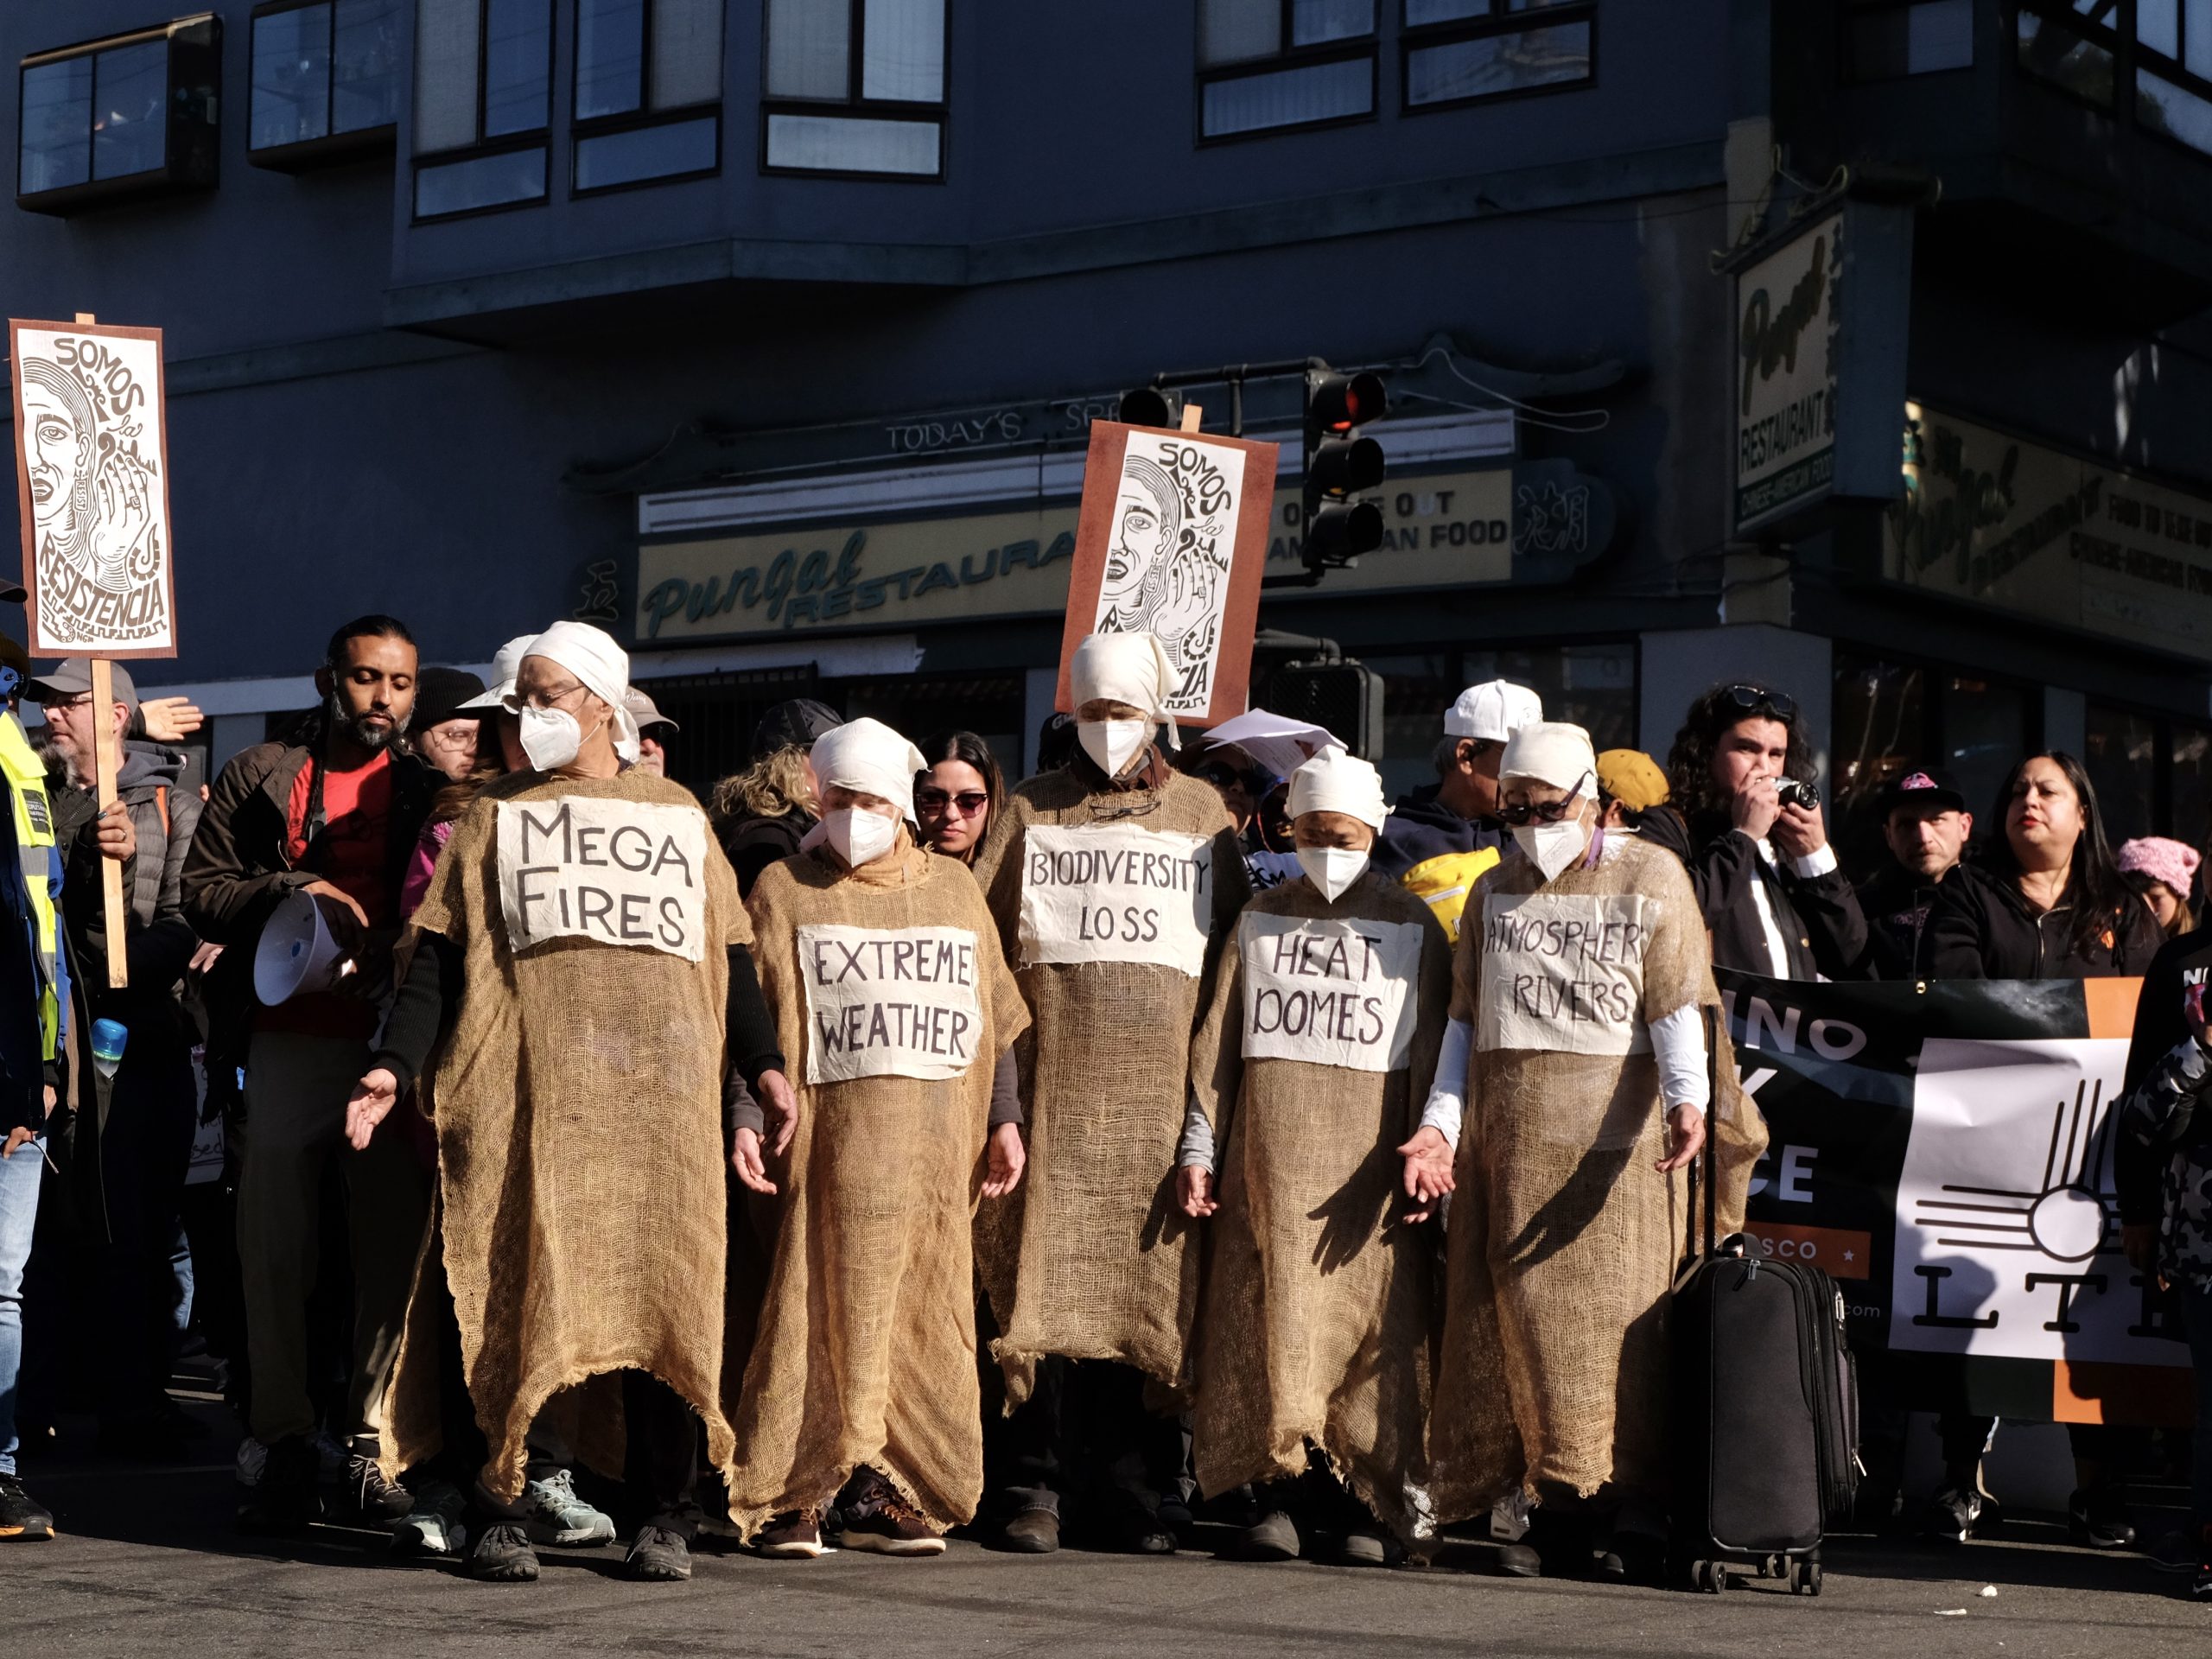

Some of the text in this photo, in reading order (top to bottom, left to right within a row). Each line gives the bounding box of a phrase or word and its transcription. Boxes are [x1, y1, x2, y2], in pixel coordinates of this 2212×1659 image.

[54, 338, 144, 416] SOMOS
[106, 415, 143, 437] la
[885, 410, 1021, 450] TODAY'S
[1741, 390, 1824, 474] RESTAURANT
[77, 481, 86, 508] RESIST
[1159, 442, 1231, 516] SOMOS
[1396, 490, 1453, 517] OUT
[1430, 520, 1507, 548] FOOD
[40, 530, 164, 627] RESISTENCIA
[520, 804, 693, 887] MEGA
[1030, 849, 1209, 894] BIODIVERSITY
[516, 867, 685, 947] FIRES
[1079, 906, 1159, 942] LOSS
[814, 940, 972, 987] EXTREME
[1273, 934, 1382, 982] HEAT
[1253, 988, 1383, 1045] DOMES
[1514, 974, 1630, 1024] RIVERS
[817, 1003, 969, 1058] WEATHER
